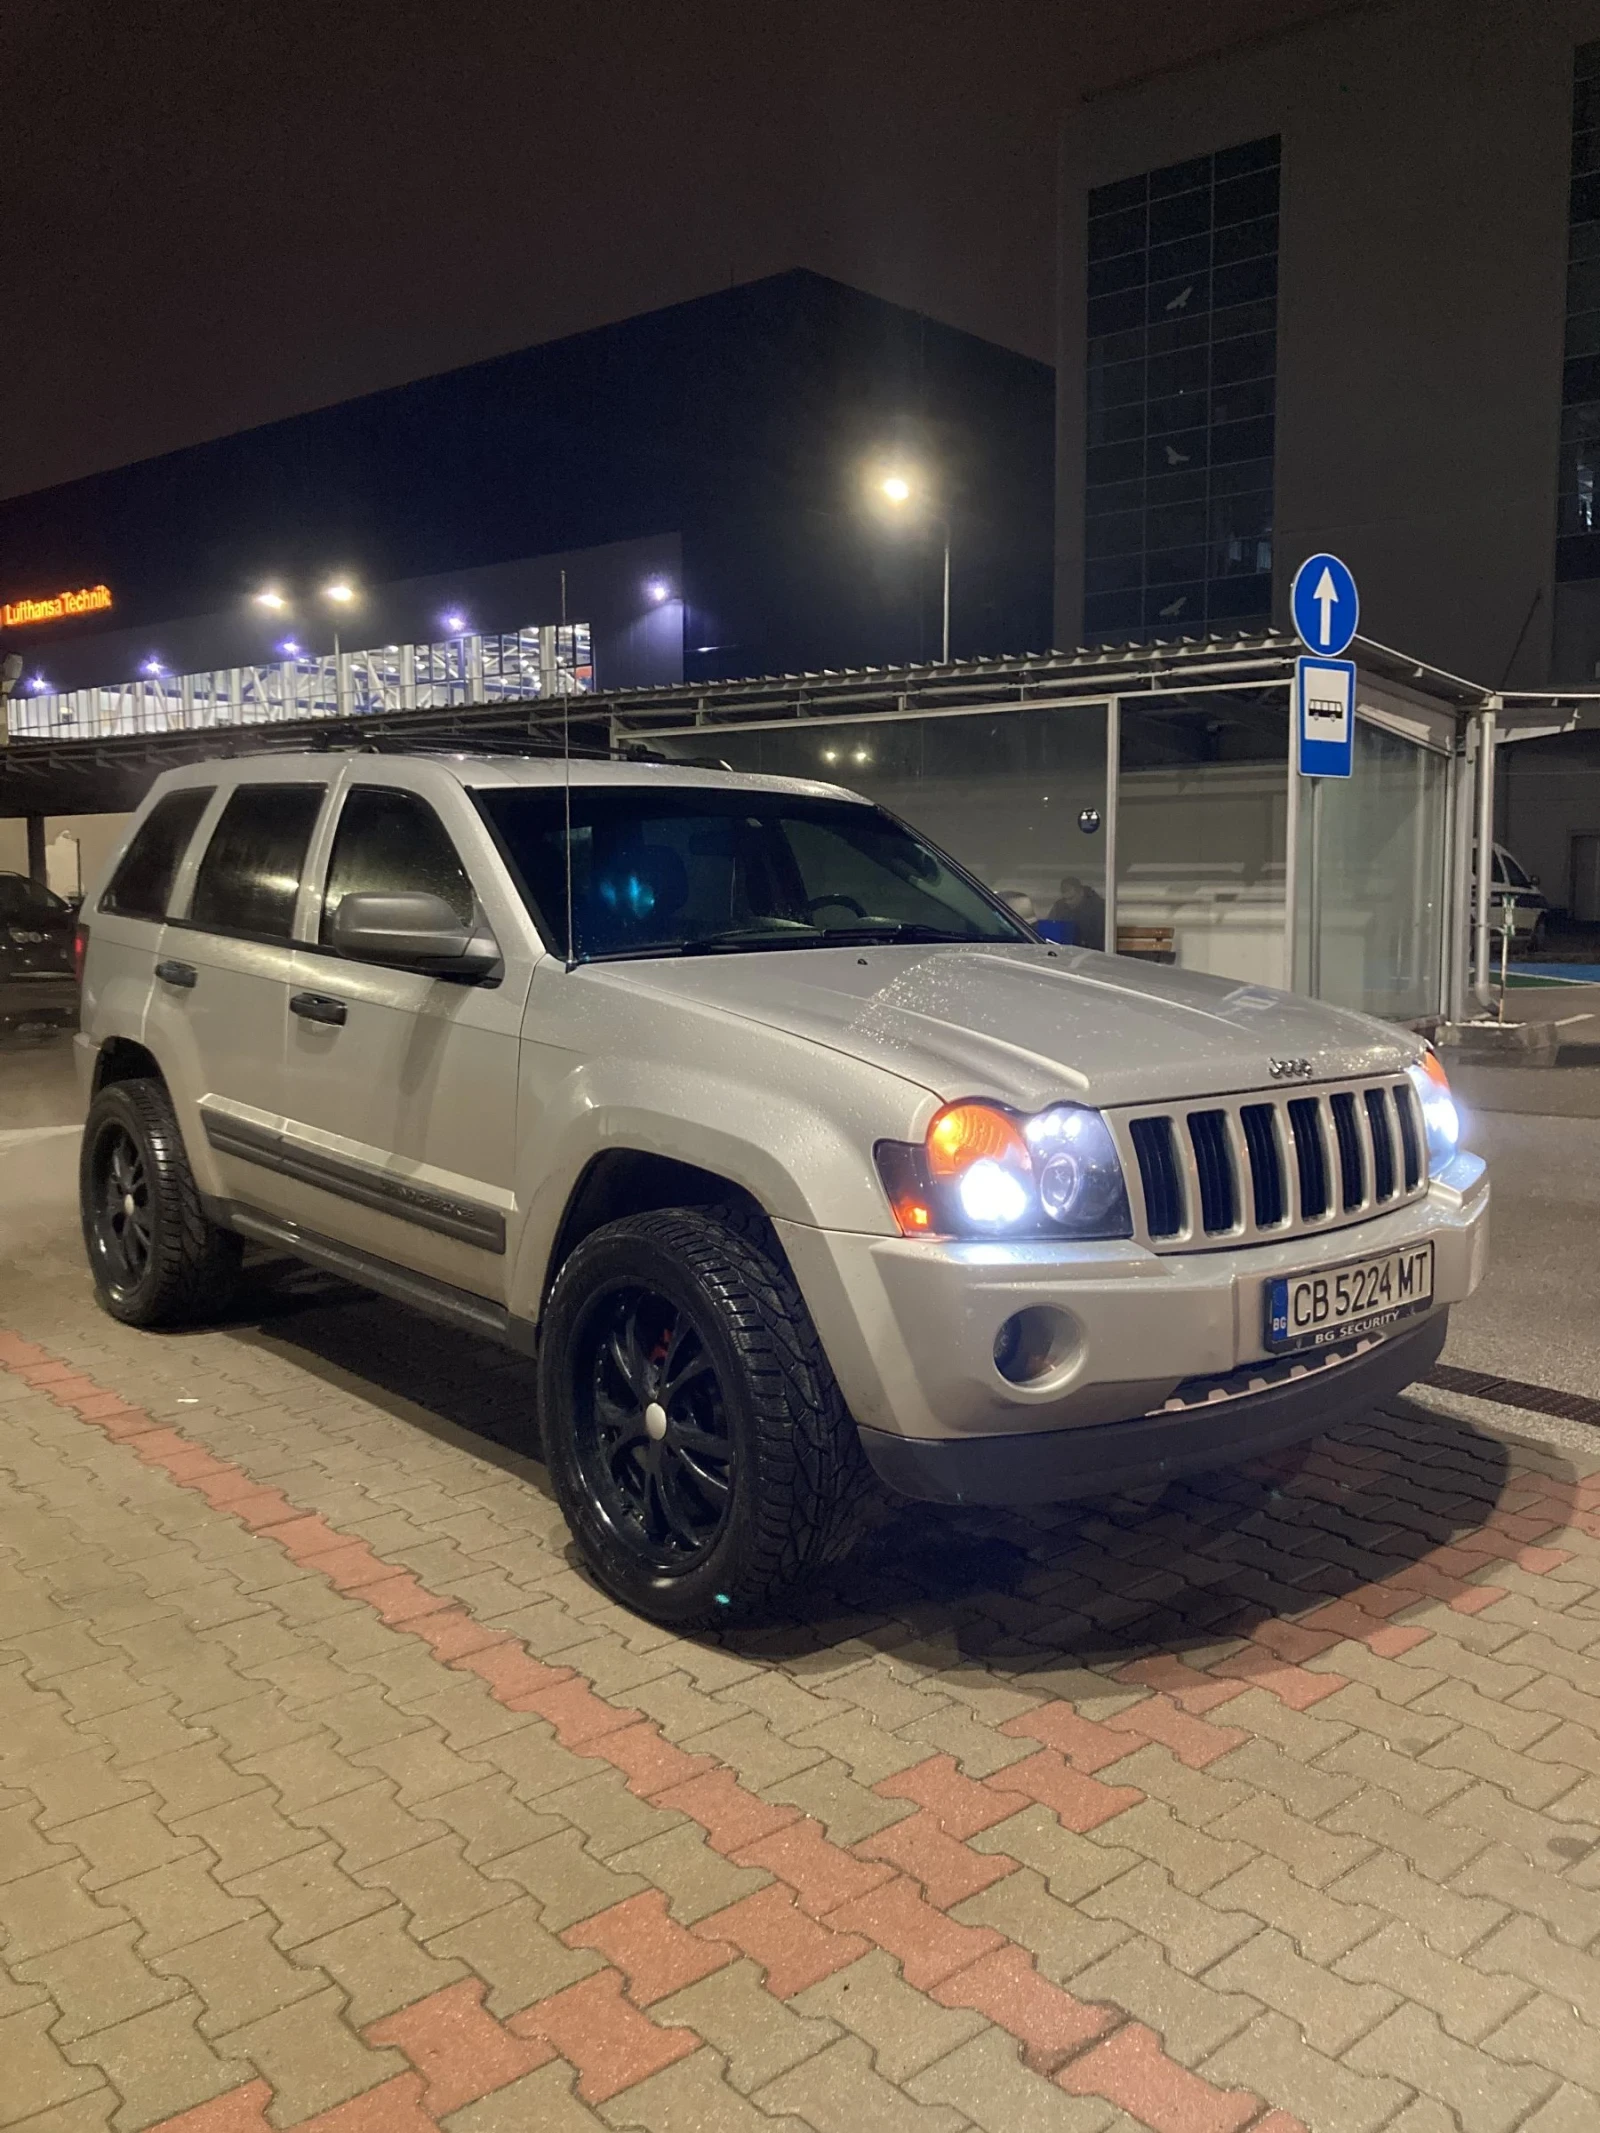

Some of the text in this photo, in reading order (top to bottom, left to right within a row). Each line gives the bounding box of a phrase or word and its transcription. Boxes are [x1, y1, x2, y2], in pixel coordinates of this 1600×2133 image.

[4, 585, 112, 625] Lufthansa Technik
[1294, 1252, 1427, 1327] CB 5224 MT
[1272, 1317, 1287, 1331] BG
[1315, 1310, 1401, 1344] BG SECURITY
